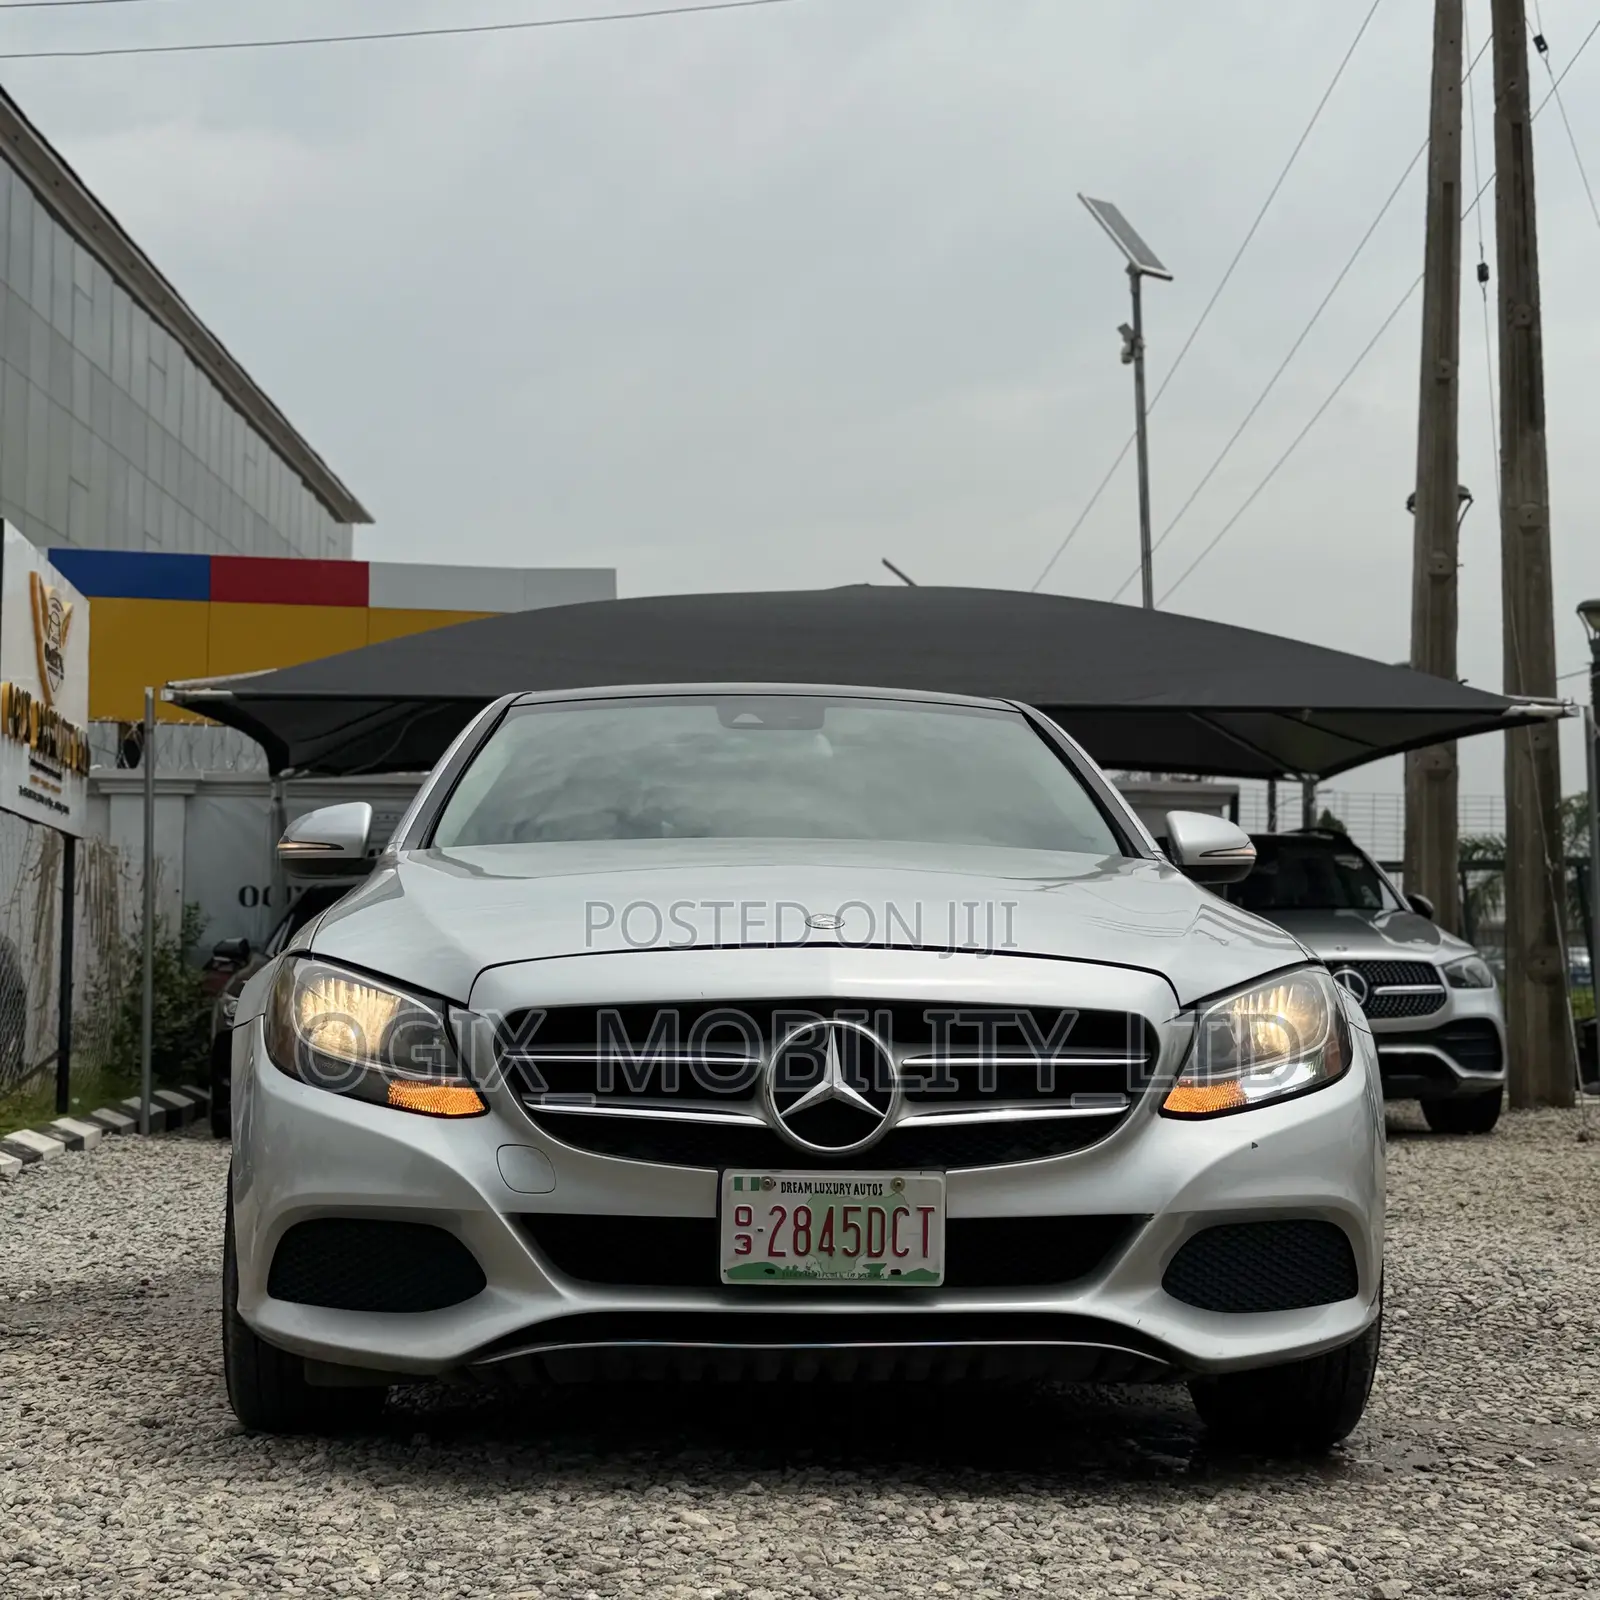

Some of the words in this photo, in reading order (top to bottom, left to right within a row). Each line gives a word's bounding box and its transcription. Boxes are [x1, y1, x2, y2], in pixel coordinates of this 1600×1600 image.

[781, 1181, 812, 1194] DREAM
[814, 1182, 852, 1195] LUXURY
[853, 1183, 883, 1196] AUTOS
